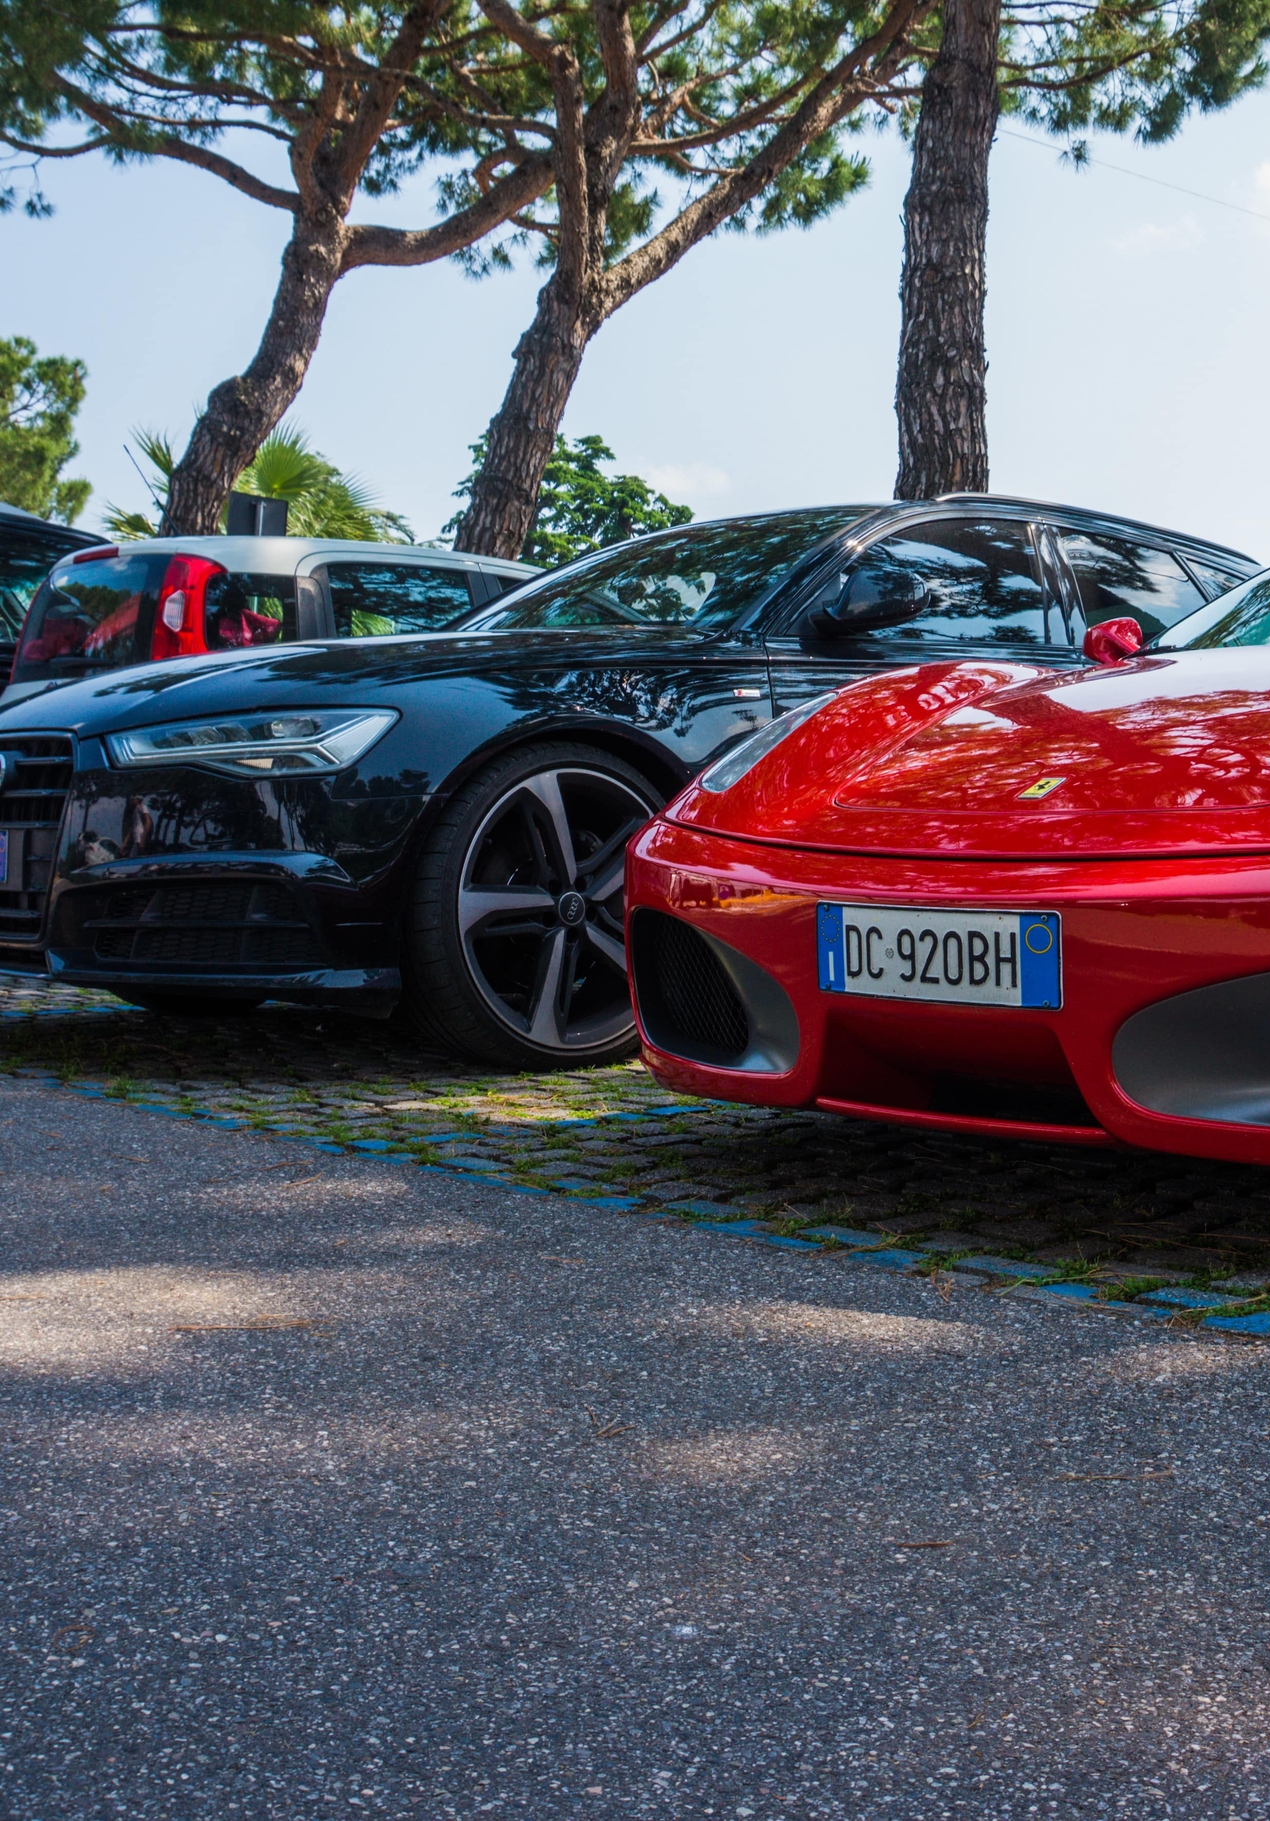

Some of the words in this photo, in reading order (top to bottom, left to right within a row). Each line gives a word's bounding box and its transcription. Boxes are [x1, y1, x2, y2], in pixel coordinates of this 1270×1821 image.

[828, 951, 835, 981] I
[845, 924, 884, 979] DC
[897, 928, 1018, 988] 920BH
